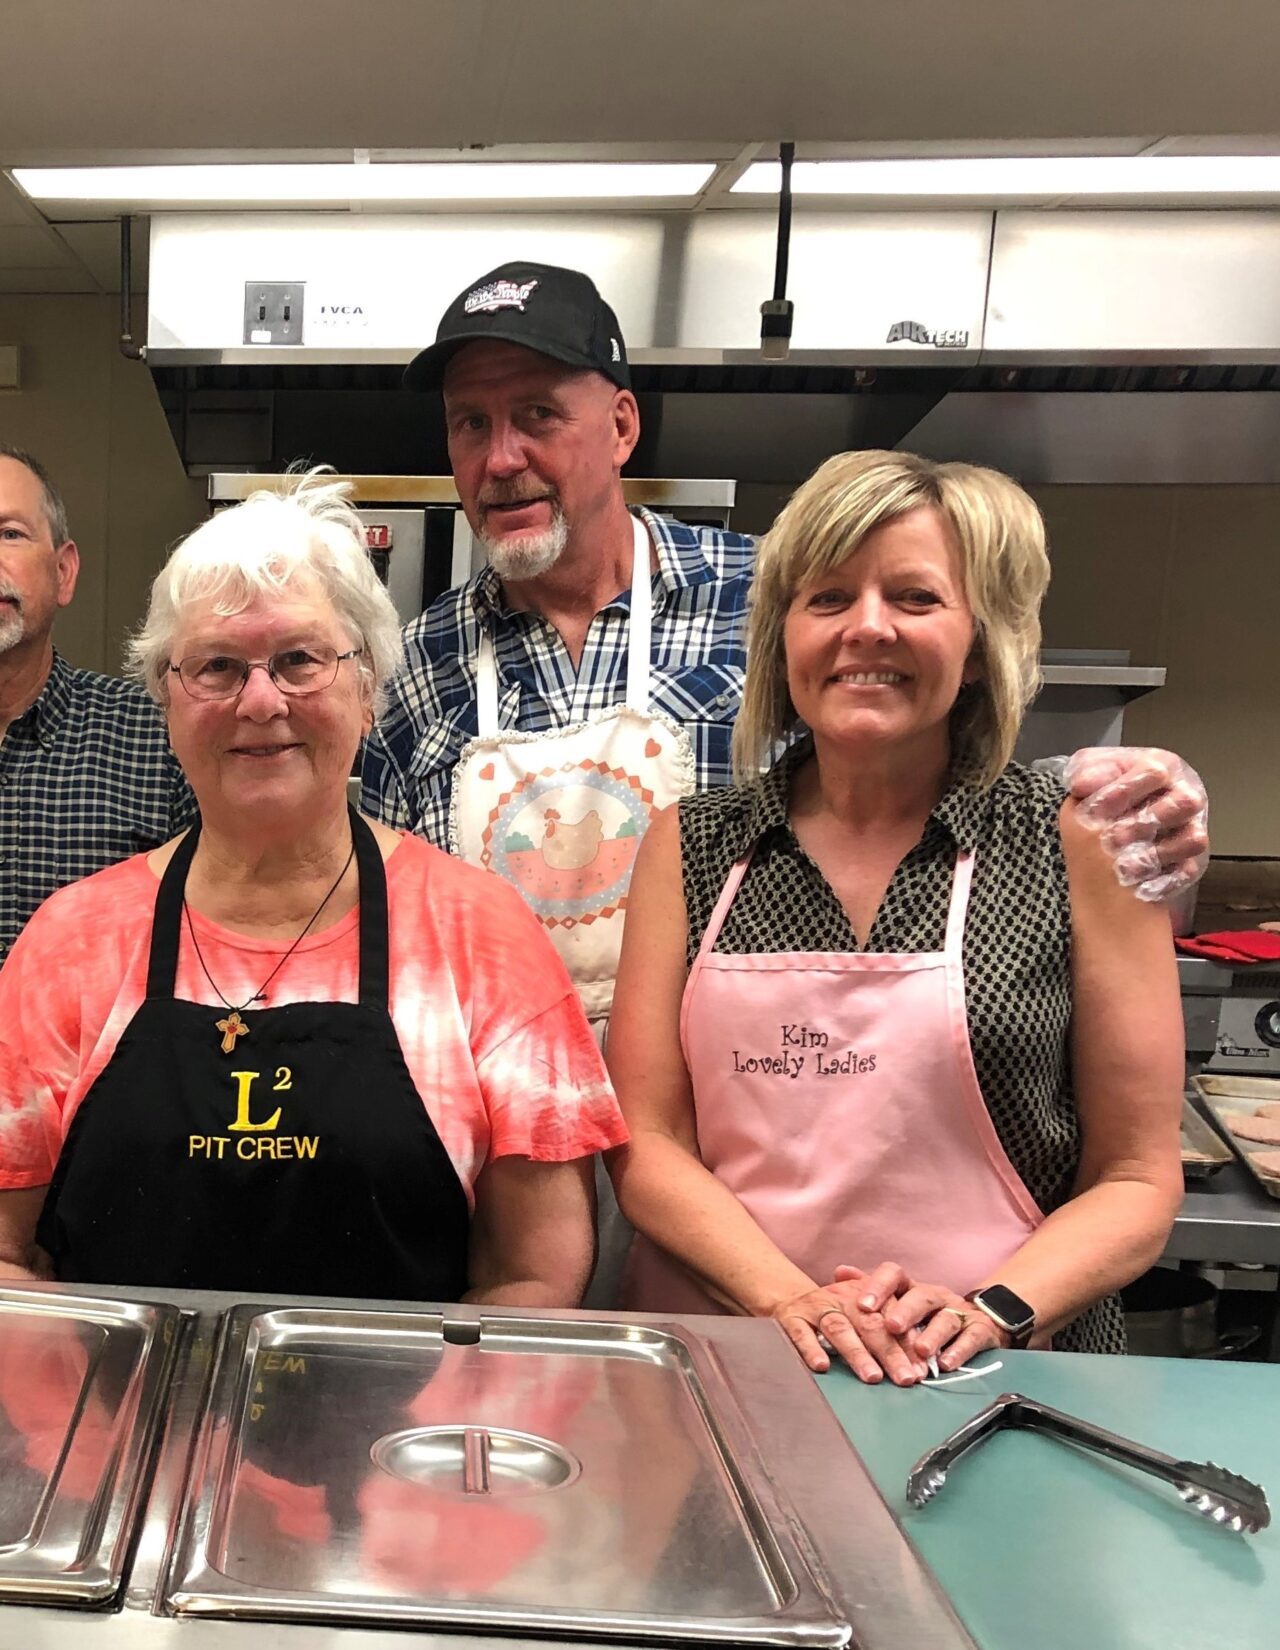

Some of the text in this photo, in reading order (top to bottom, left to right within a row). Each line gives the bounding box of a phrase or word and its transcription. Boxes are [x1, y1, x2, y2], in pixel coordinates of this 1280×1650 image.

[780, 1024, 829, 1048] Kim
[732, 1050, 877, 1079] Lovely Ladies
[189, 1135, 320, 1160] PIT CREW
